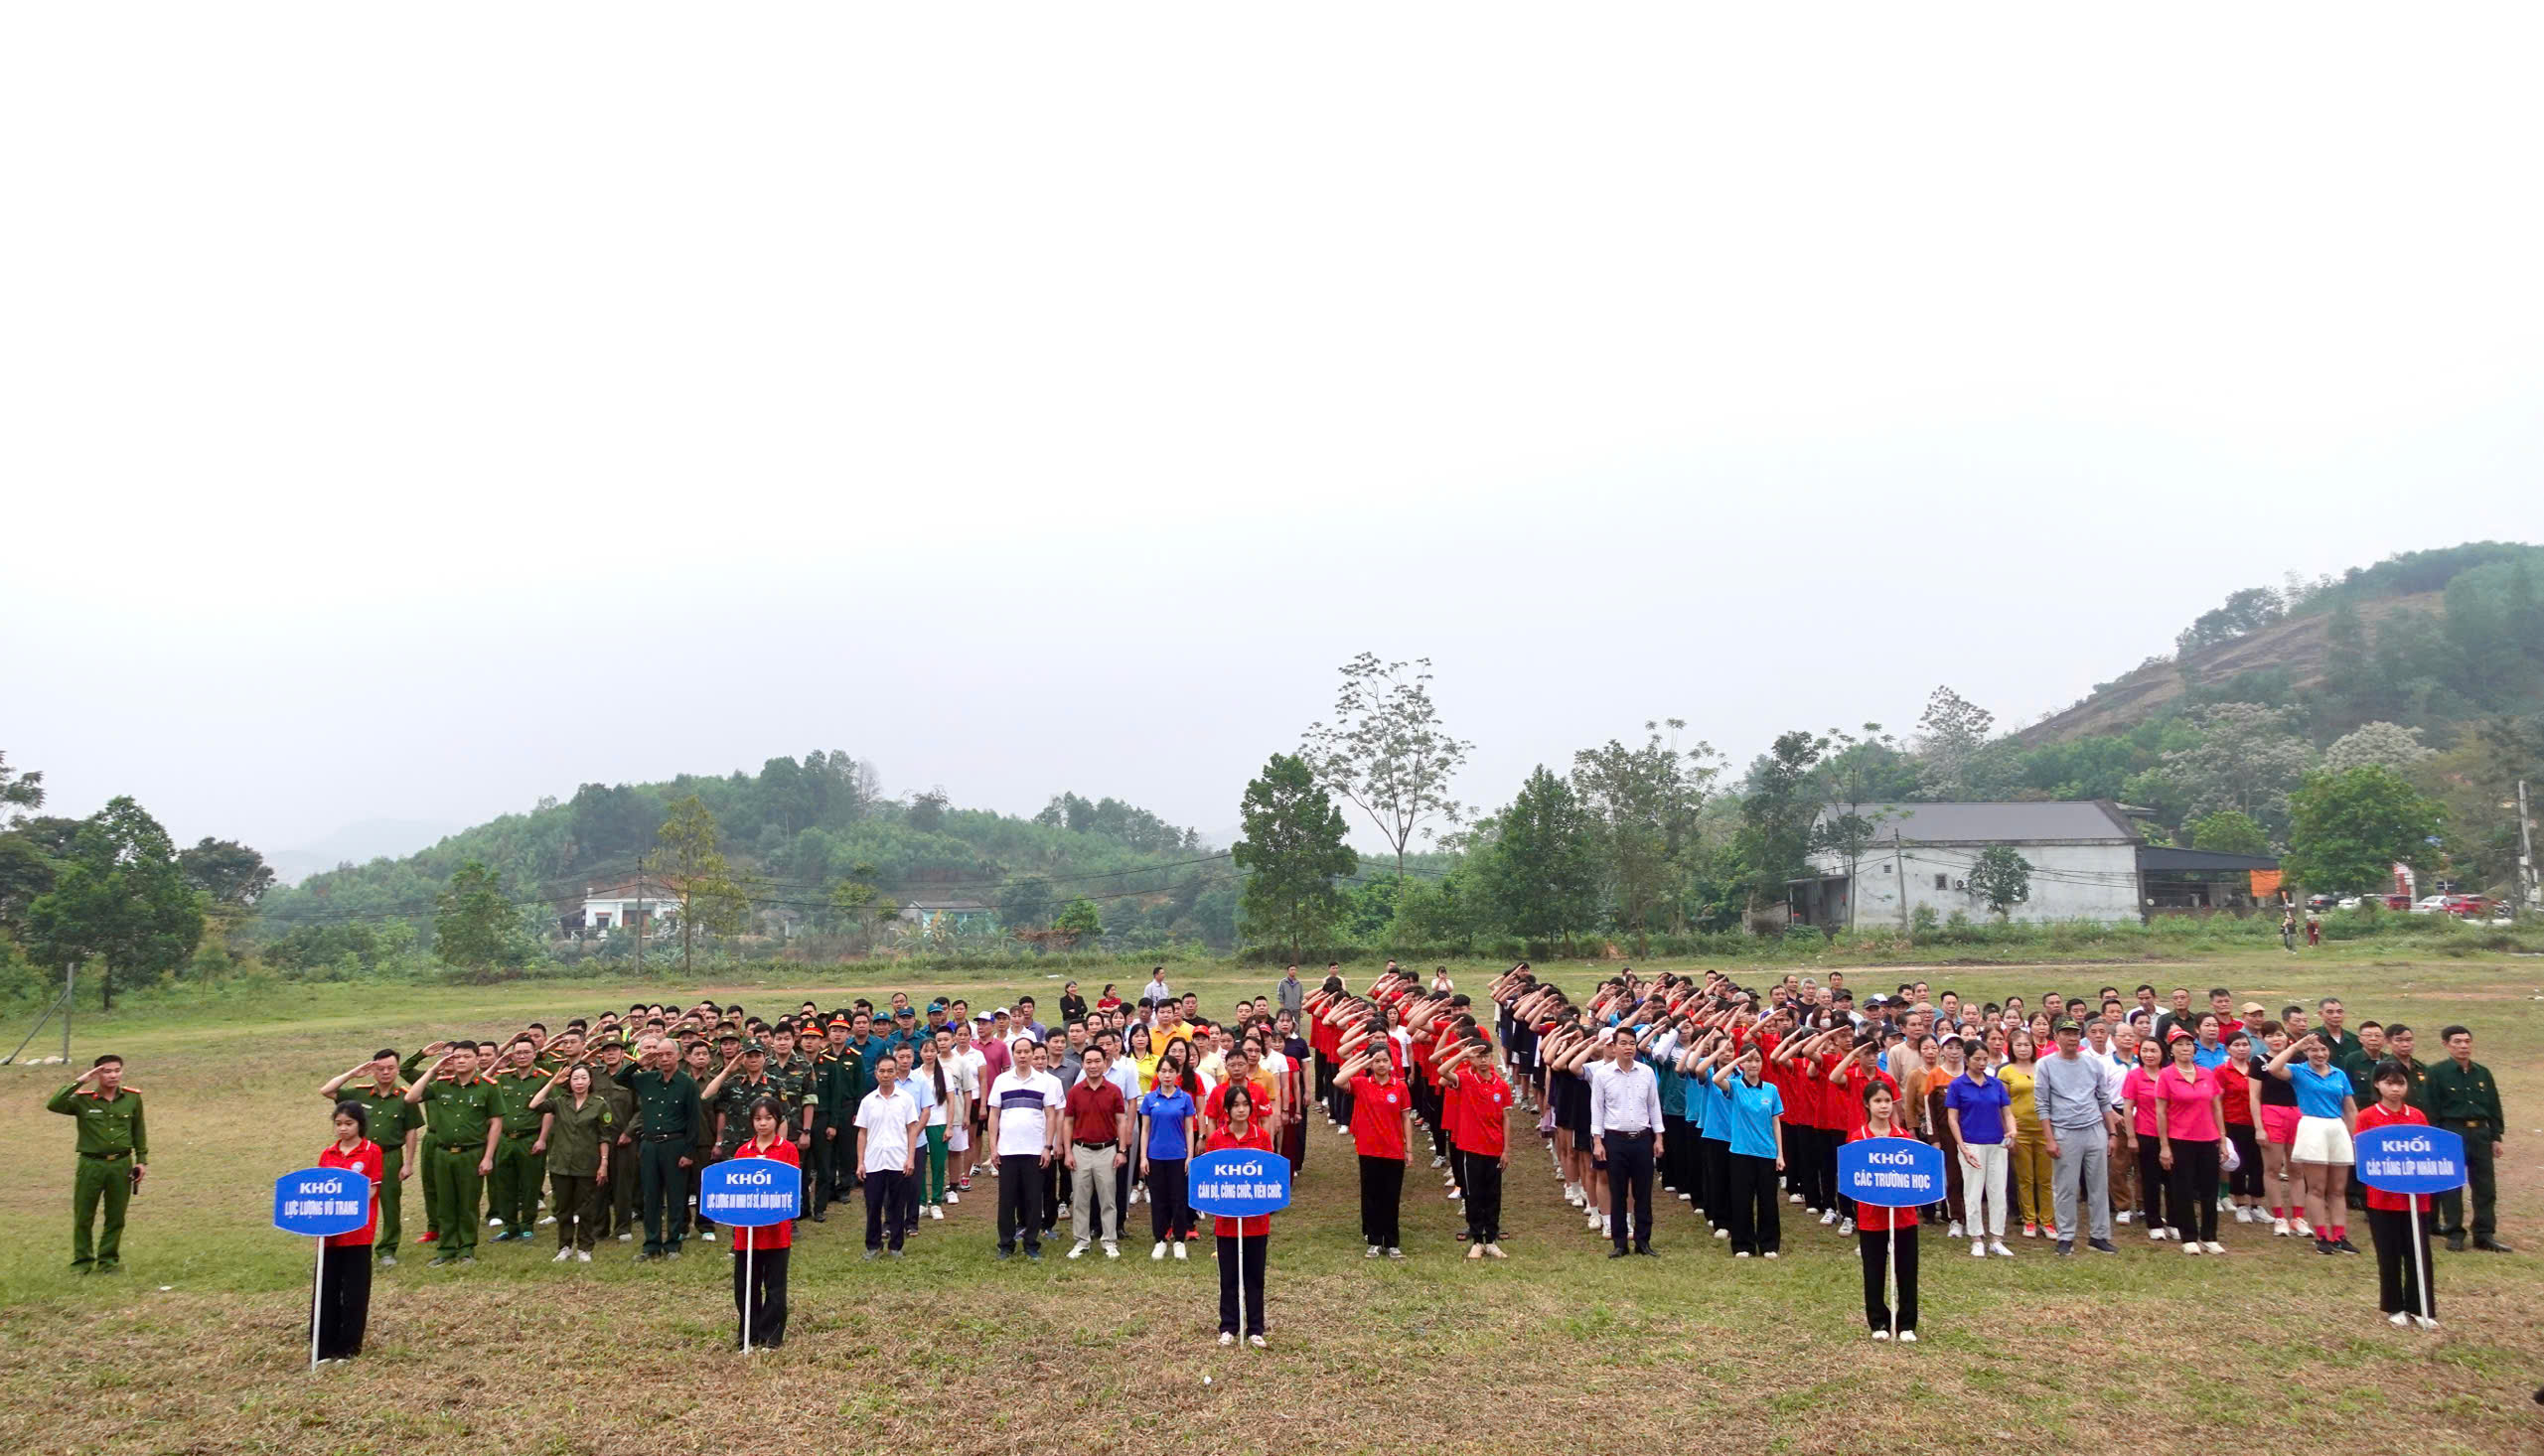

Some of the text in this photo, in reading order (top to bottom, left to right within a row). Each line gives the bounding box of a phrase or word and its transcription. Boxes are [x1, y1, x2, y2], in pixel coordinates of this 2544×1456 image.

[2382, 1135, 2431, 1152] KHỐI
[1868, 1149, 1914, 1165] KHỐI
[1215, 1160, 1263, 1176] KHỐI
[2366, 1156, 2455, 1176] CÁC TẦNG LỚP NHÂN DÂN
[726, 1168, 771, 1184] KHỐI
[1854, 1169, 1931, 1192] CÁC TRƯỜNG HỌC
[300, 1177, 342, 1194] KHỐI
[1198, 1180, 1282, 1202] CÁN BỘ, CÔNG CHỨC, VIÊN CHỨC
[285, 1200, 299, 1219] LỰC
[299, 1200, 323, 1219] LƯỢNG
[335, 1201, 359, 1215] TRANG
